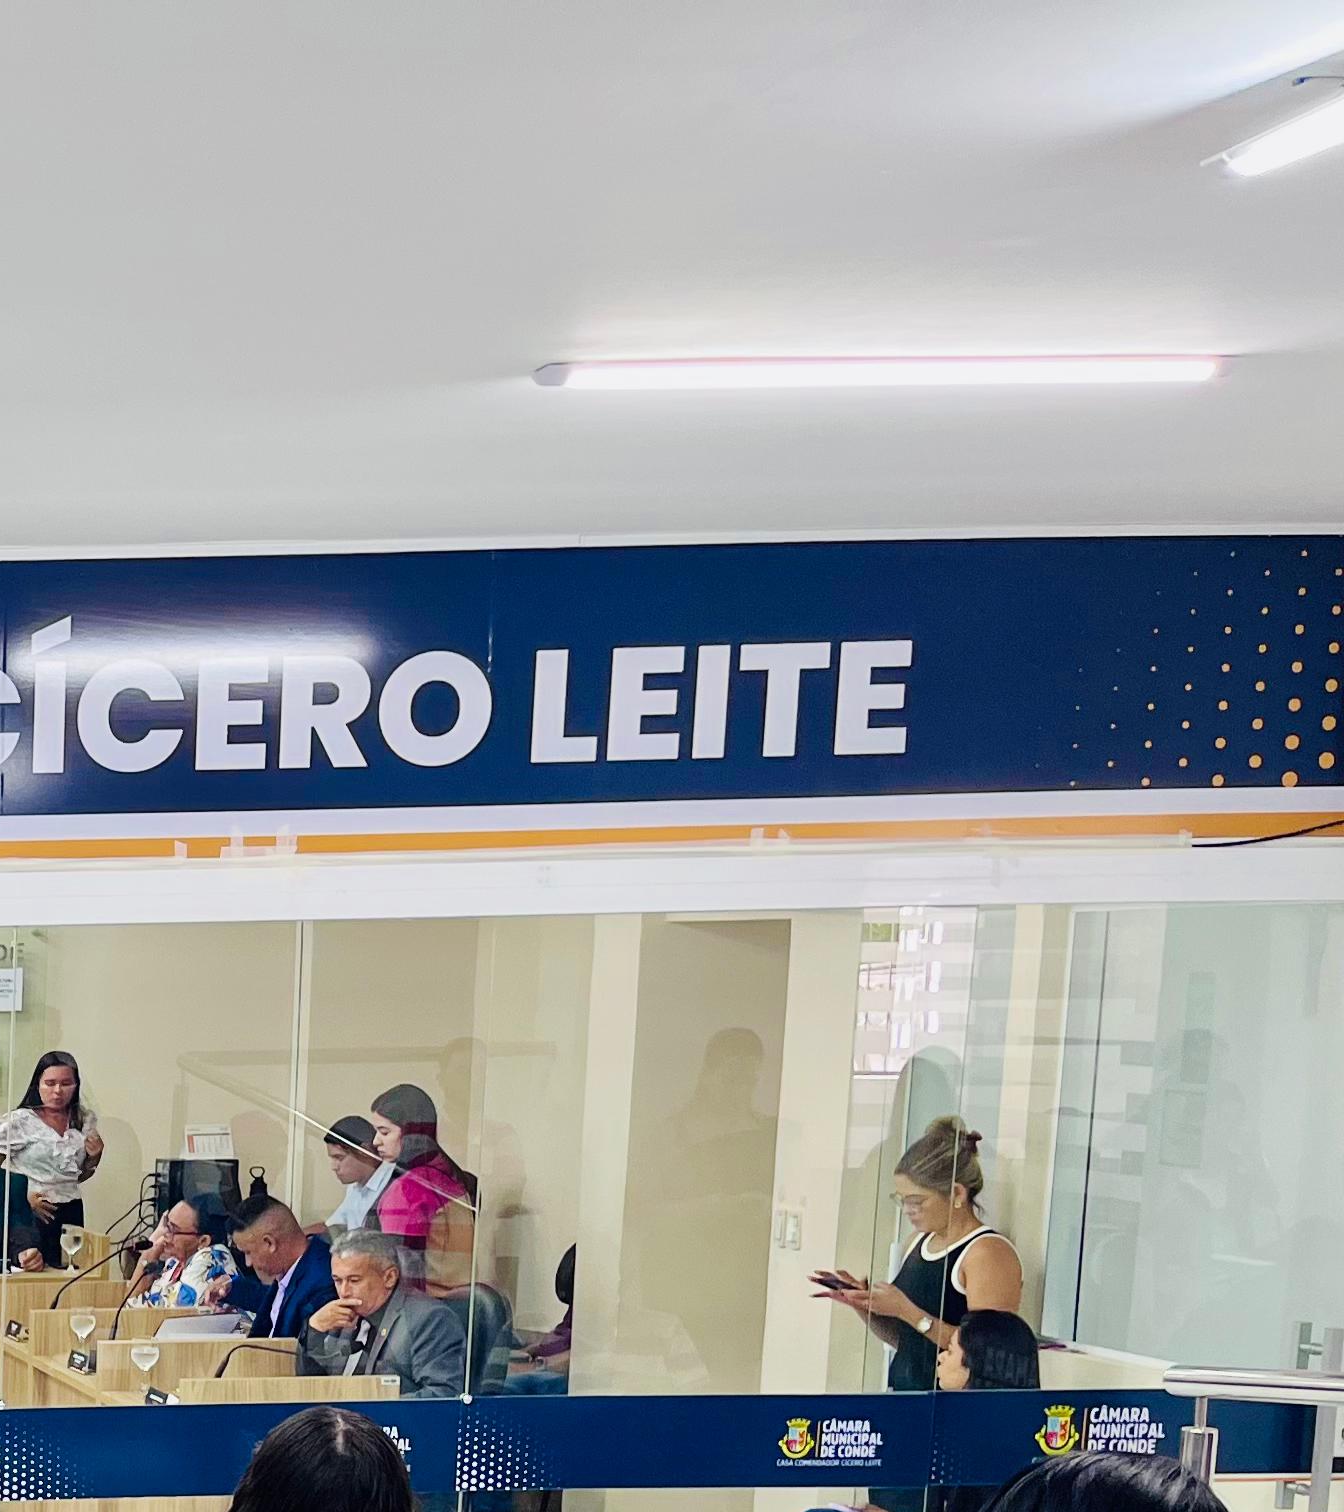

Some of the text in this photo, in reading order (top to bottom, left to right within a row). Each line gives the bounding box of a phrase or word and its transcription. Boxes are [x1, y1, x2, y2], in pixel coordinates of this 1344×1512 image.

[529, 640, 913, 765] LEITE
[1089, 1404, 1150, 1422] CÂMARA
[822, 1417, 870, 1432] CÂMARA
[1088, 1423, 1166, 1439] MUNICIPAL
[821, 1432, 883, 1445] MUNICIPAL
[1087, 1438, 1157, 1455] DE CONDE
[820, 1445, 876, 1458] DE CONDE
